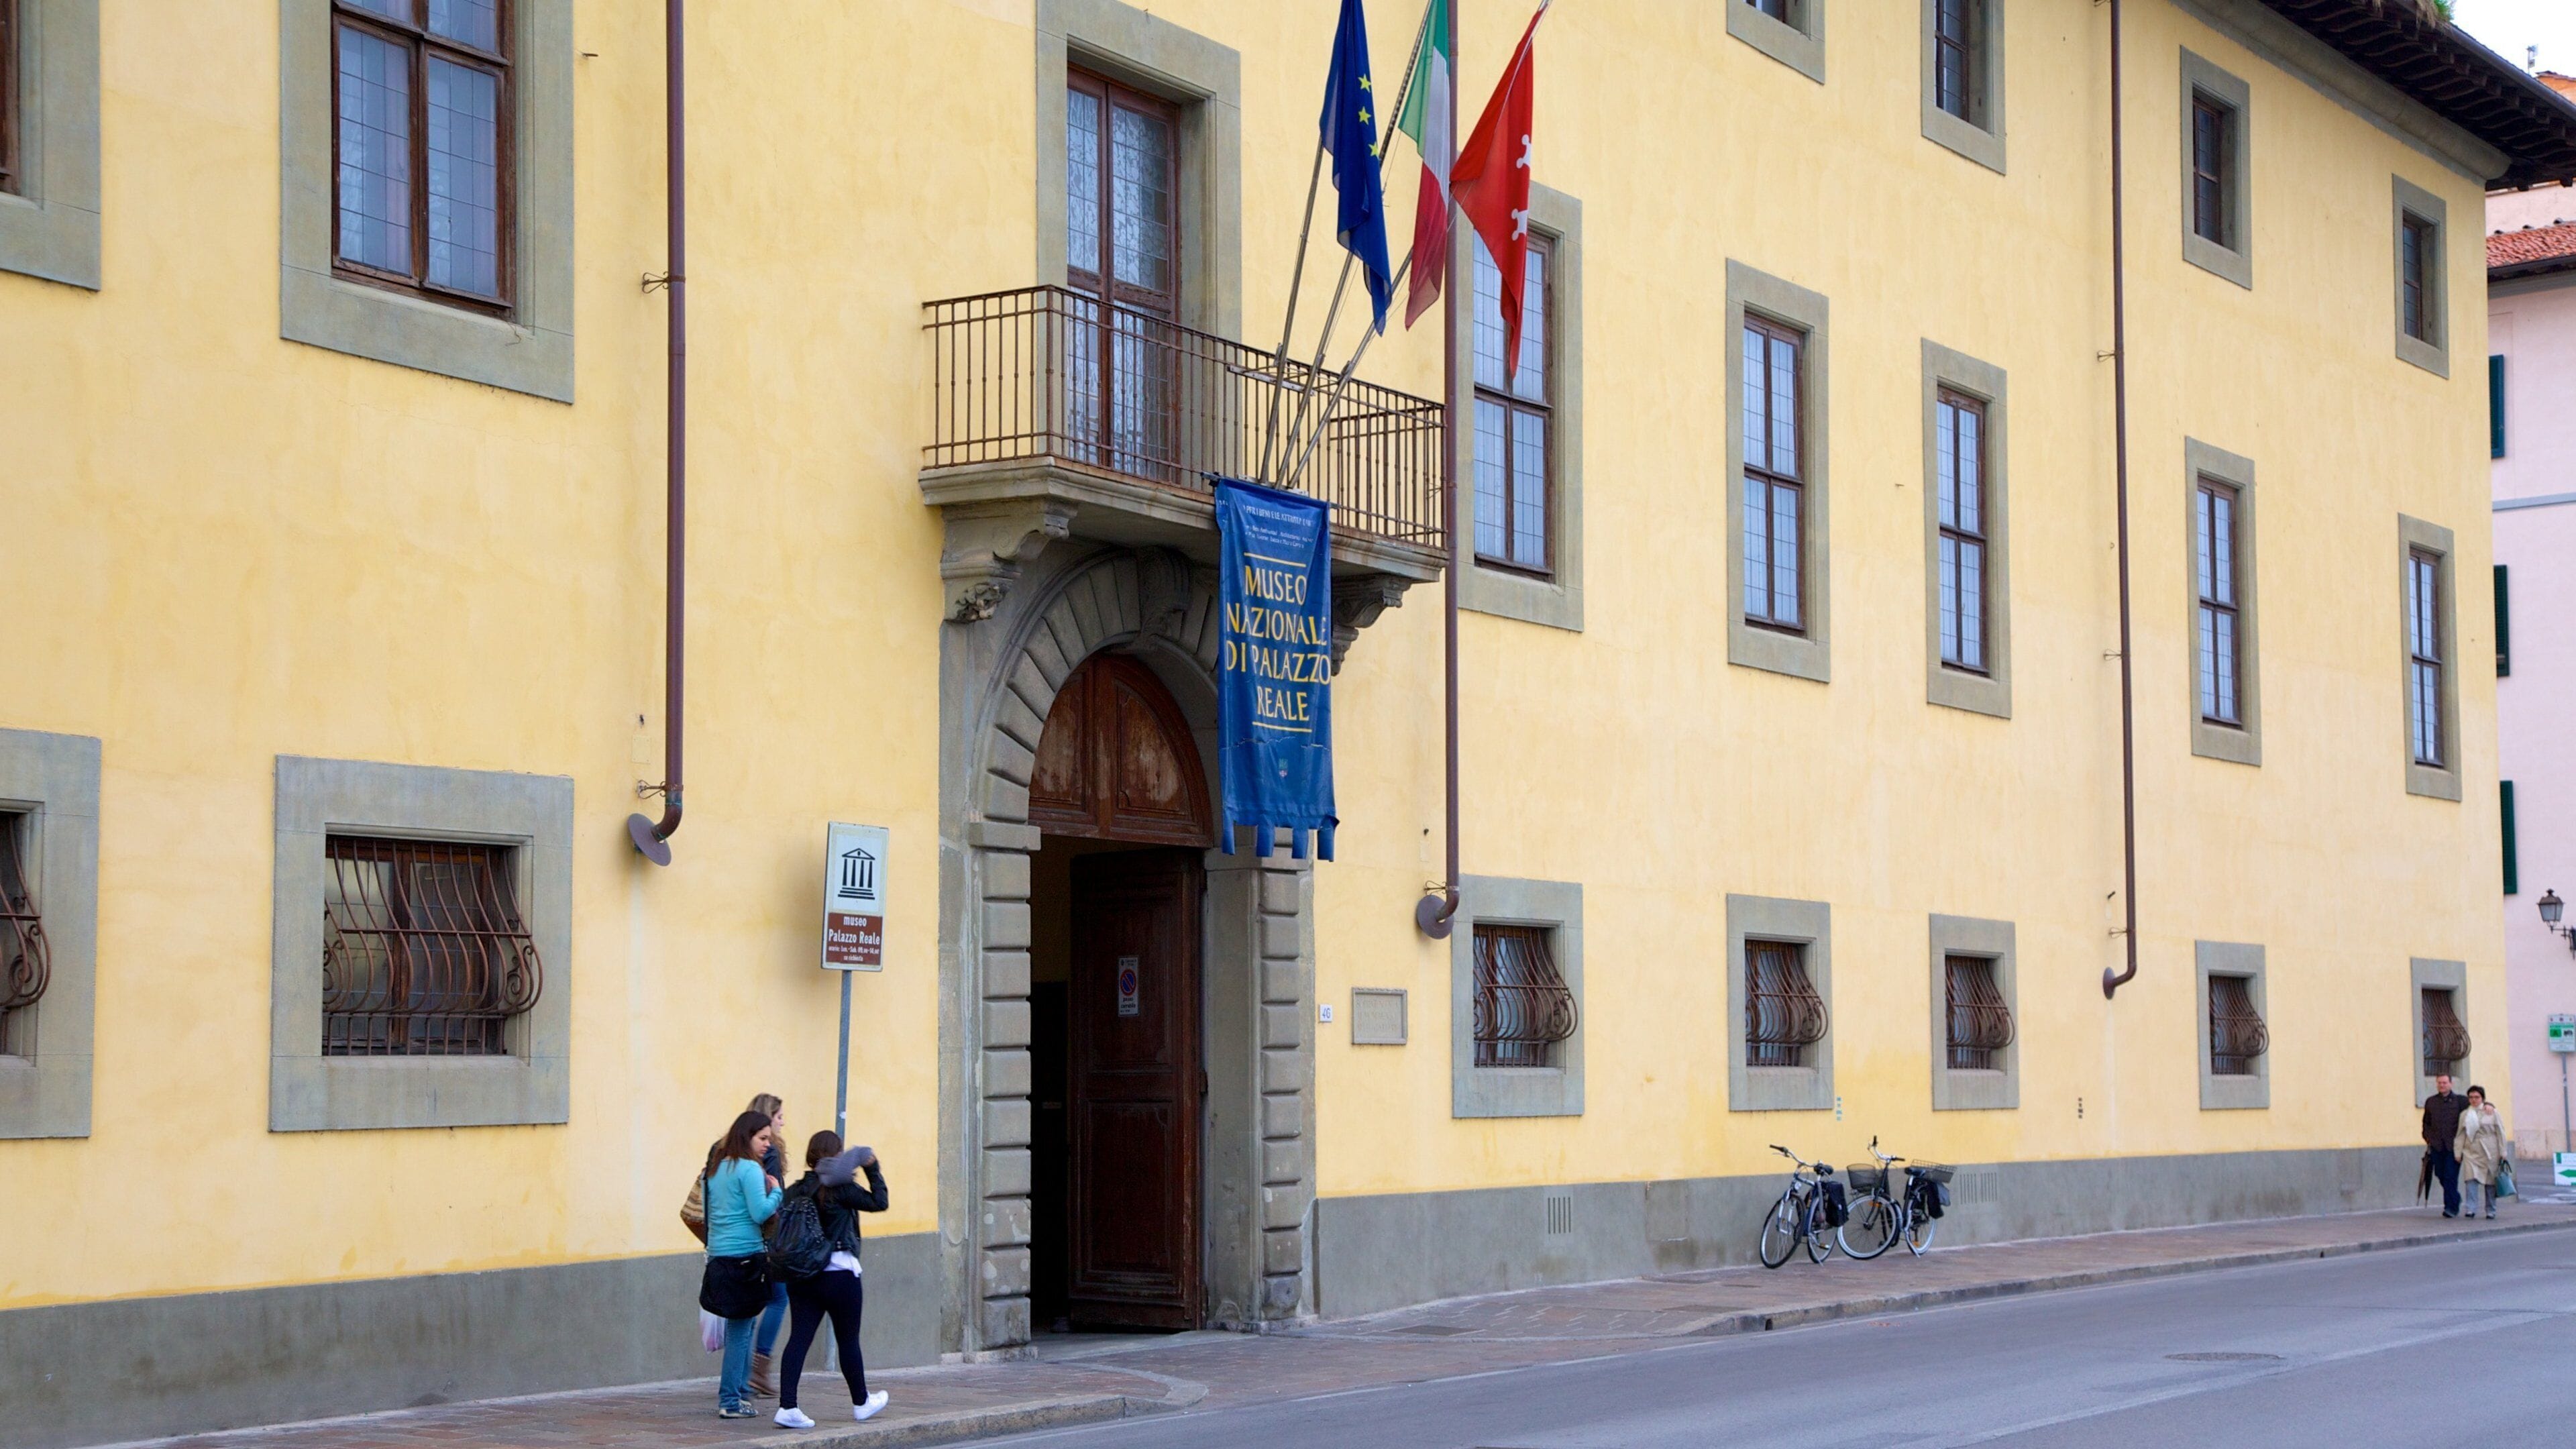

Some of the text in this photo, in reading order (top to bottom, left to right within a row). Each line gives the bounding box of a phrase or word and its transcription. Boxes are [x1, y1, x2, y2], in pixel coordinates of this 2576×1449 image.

[1245, 565, 1307, 606] MUSEO
[1226, 602, 1328, 646] NAZIONALE
[1226, 640, 1331, 685] DI PALAZZO
[1257, 685, 1309, 721] REALE
[828, 928, 881, 945] Palazzo Reale
[843, 916, 867, 926] museo
